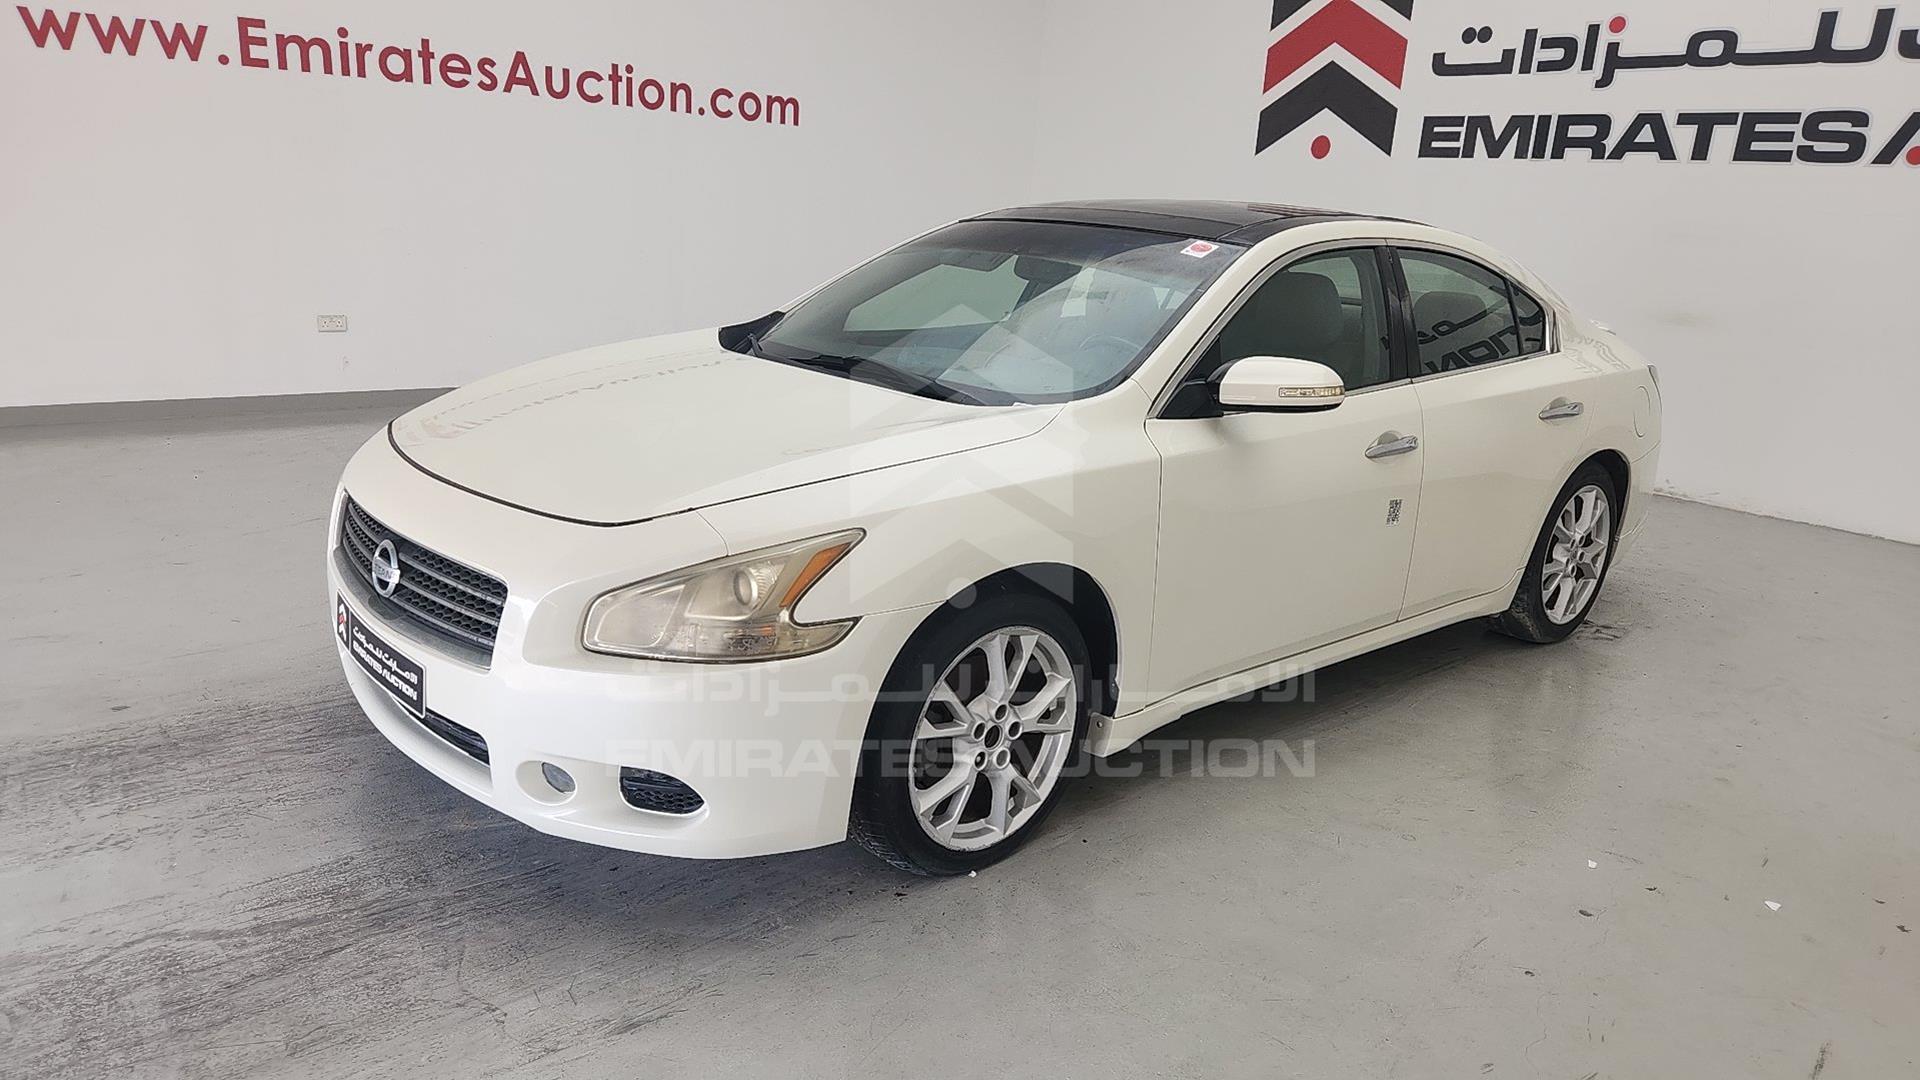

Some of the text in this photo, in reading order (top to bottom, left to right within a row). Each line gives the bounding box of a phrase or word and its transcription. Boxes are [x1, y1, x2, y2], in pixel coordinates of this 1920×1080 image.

[18, 6, 800, 125] www.EmiratesAuction.com
[1432, 6, 1896, 89] للمزادات
[1418, 111, 1870, 163] EMIRATES
